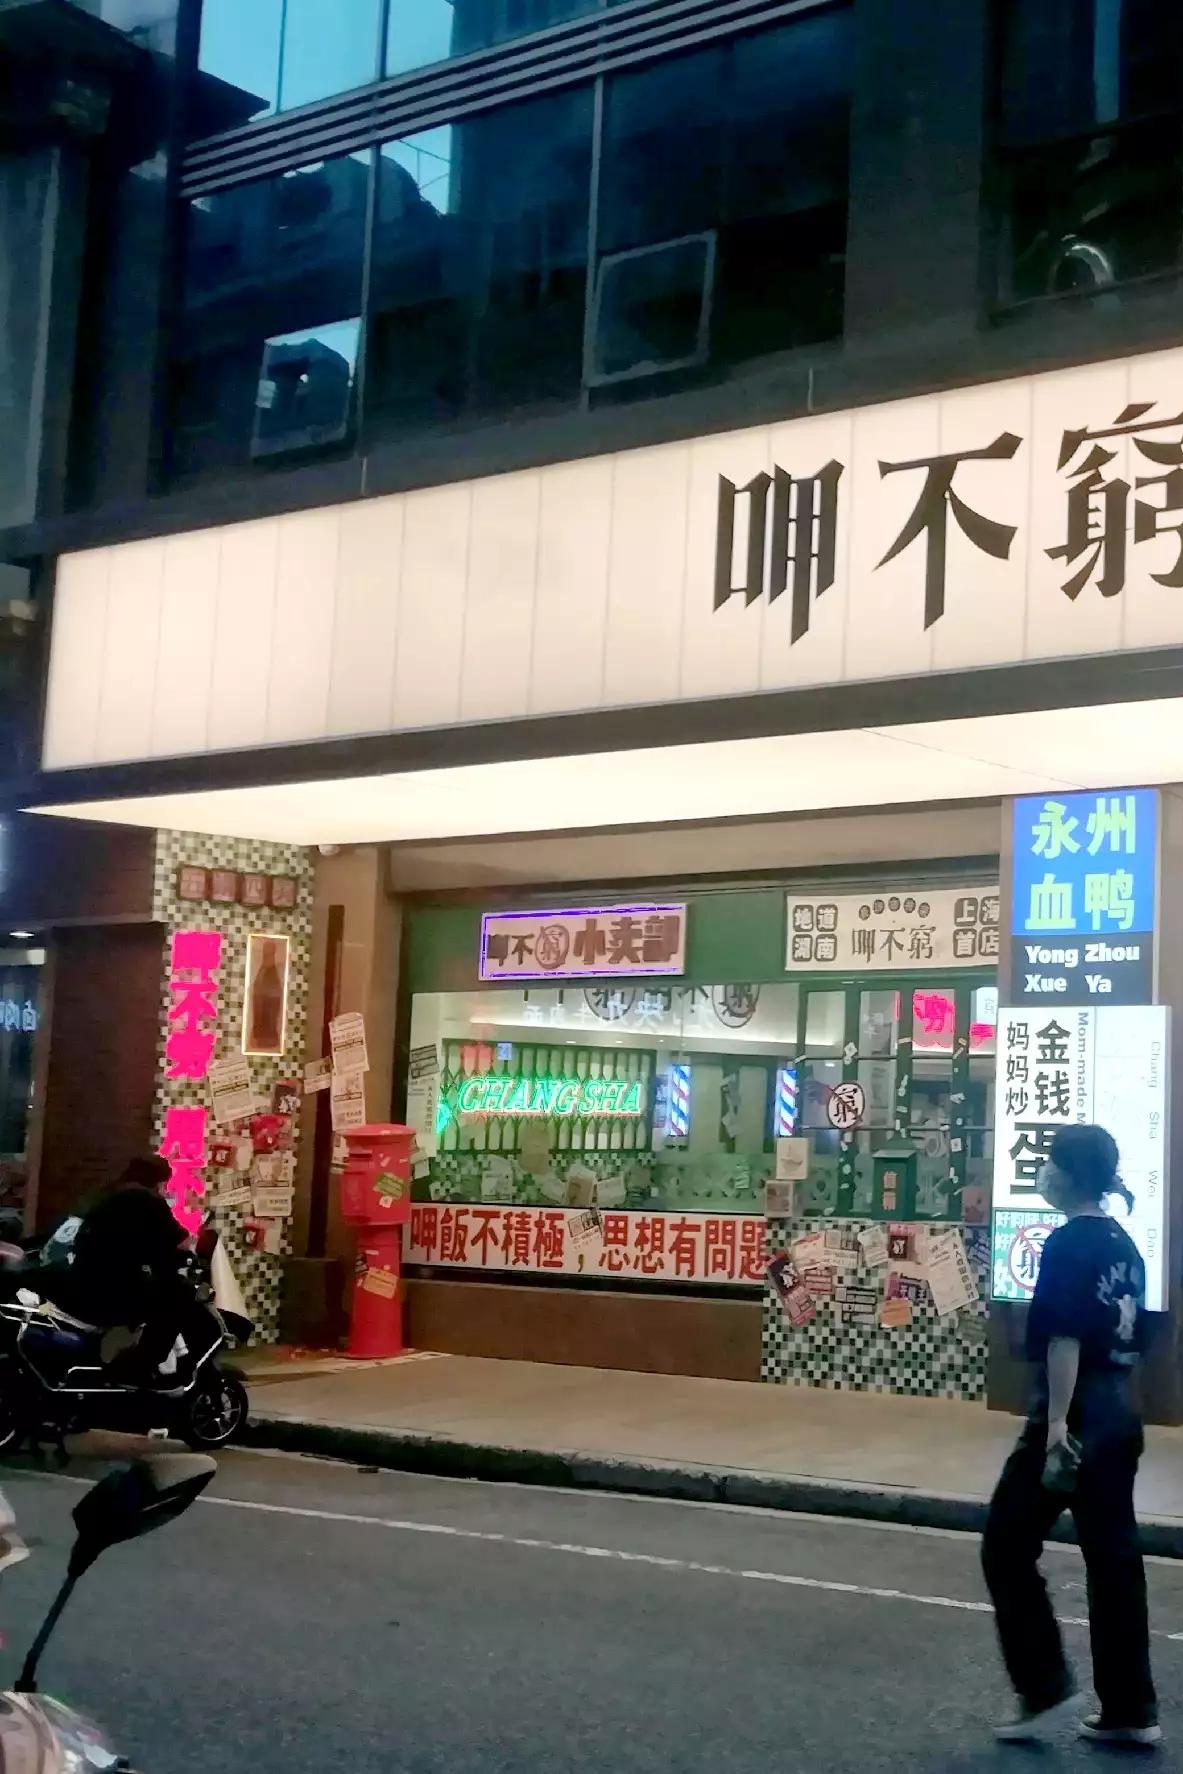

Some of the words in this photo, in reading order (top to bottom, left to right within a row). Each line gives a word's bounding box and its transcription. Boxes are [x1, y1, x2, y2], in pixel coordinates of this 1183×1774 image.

[1031, 795, 1136, 859] 永州
[1025, 868, 1135, 930] 血鸭
[1025, 945, 1079, 967] Yong
[1085, 943, 1140, 962] Zhou
[1024, 974, 1067, 993] Xue
[1085, 974, 1112, 993] Ya
[1005, 1020, 1030, 1117] 妈妈炒
[1077, 1012, 1089, 1108] Mom-made
[1147, 1040, 1161, 1089] Chang
[1148, 1112, 1160, 1140] Sha
